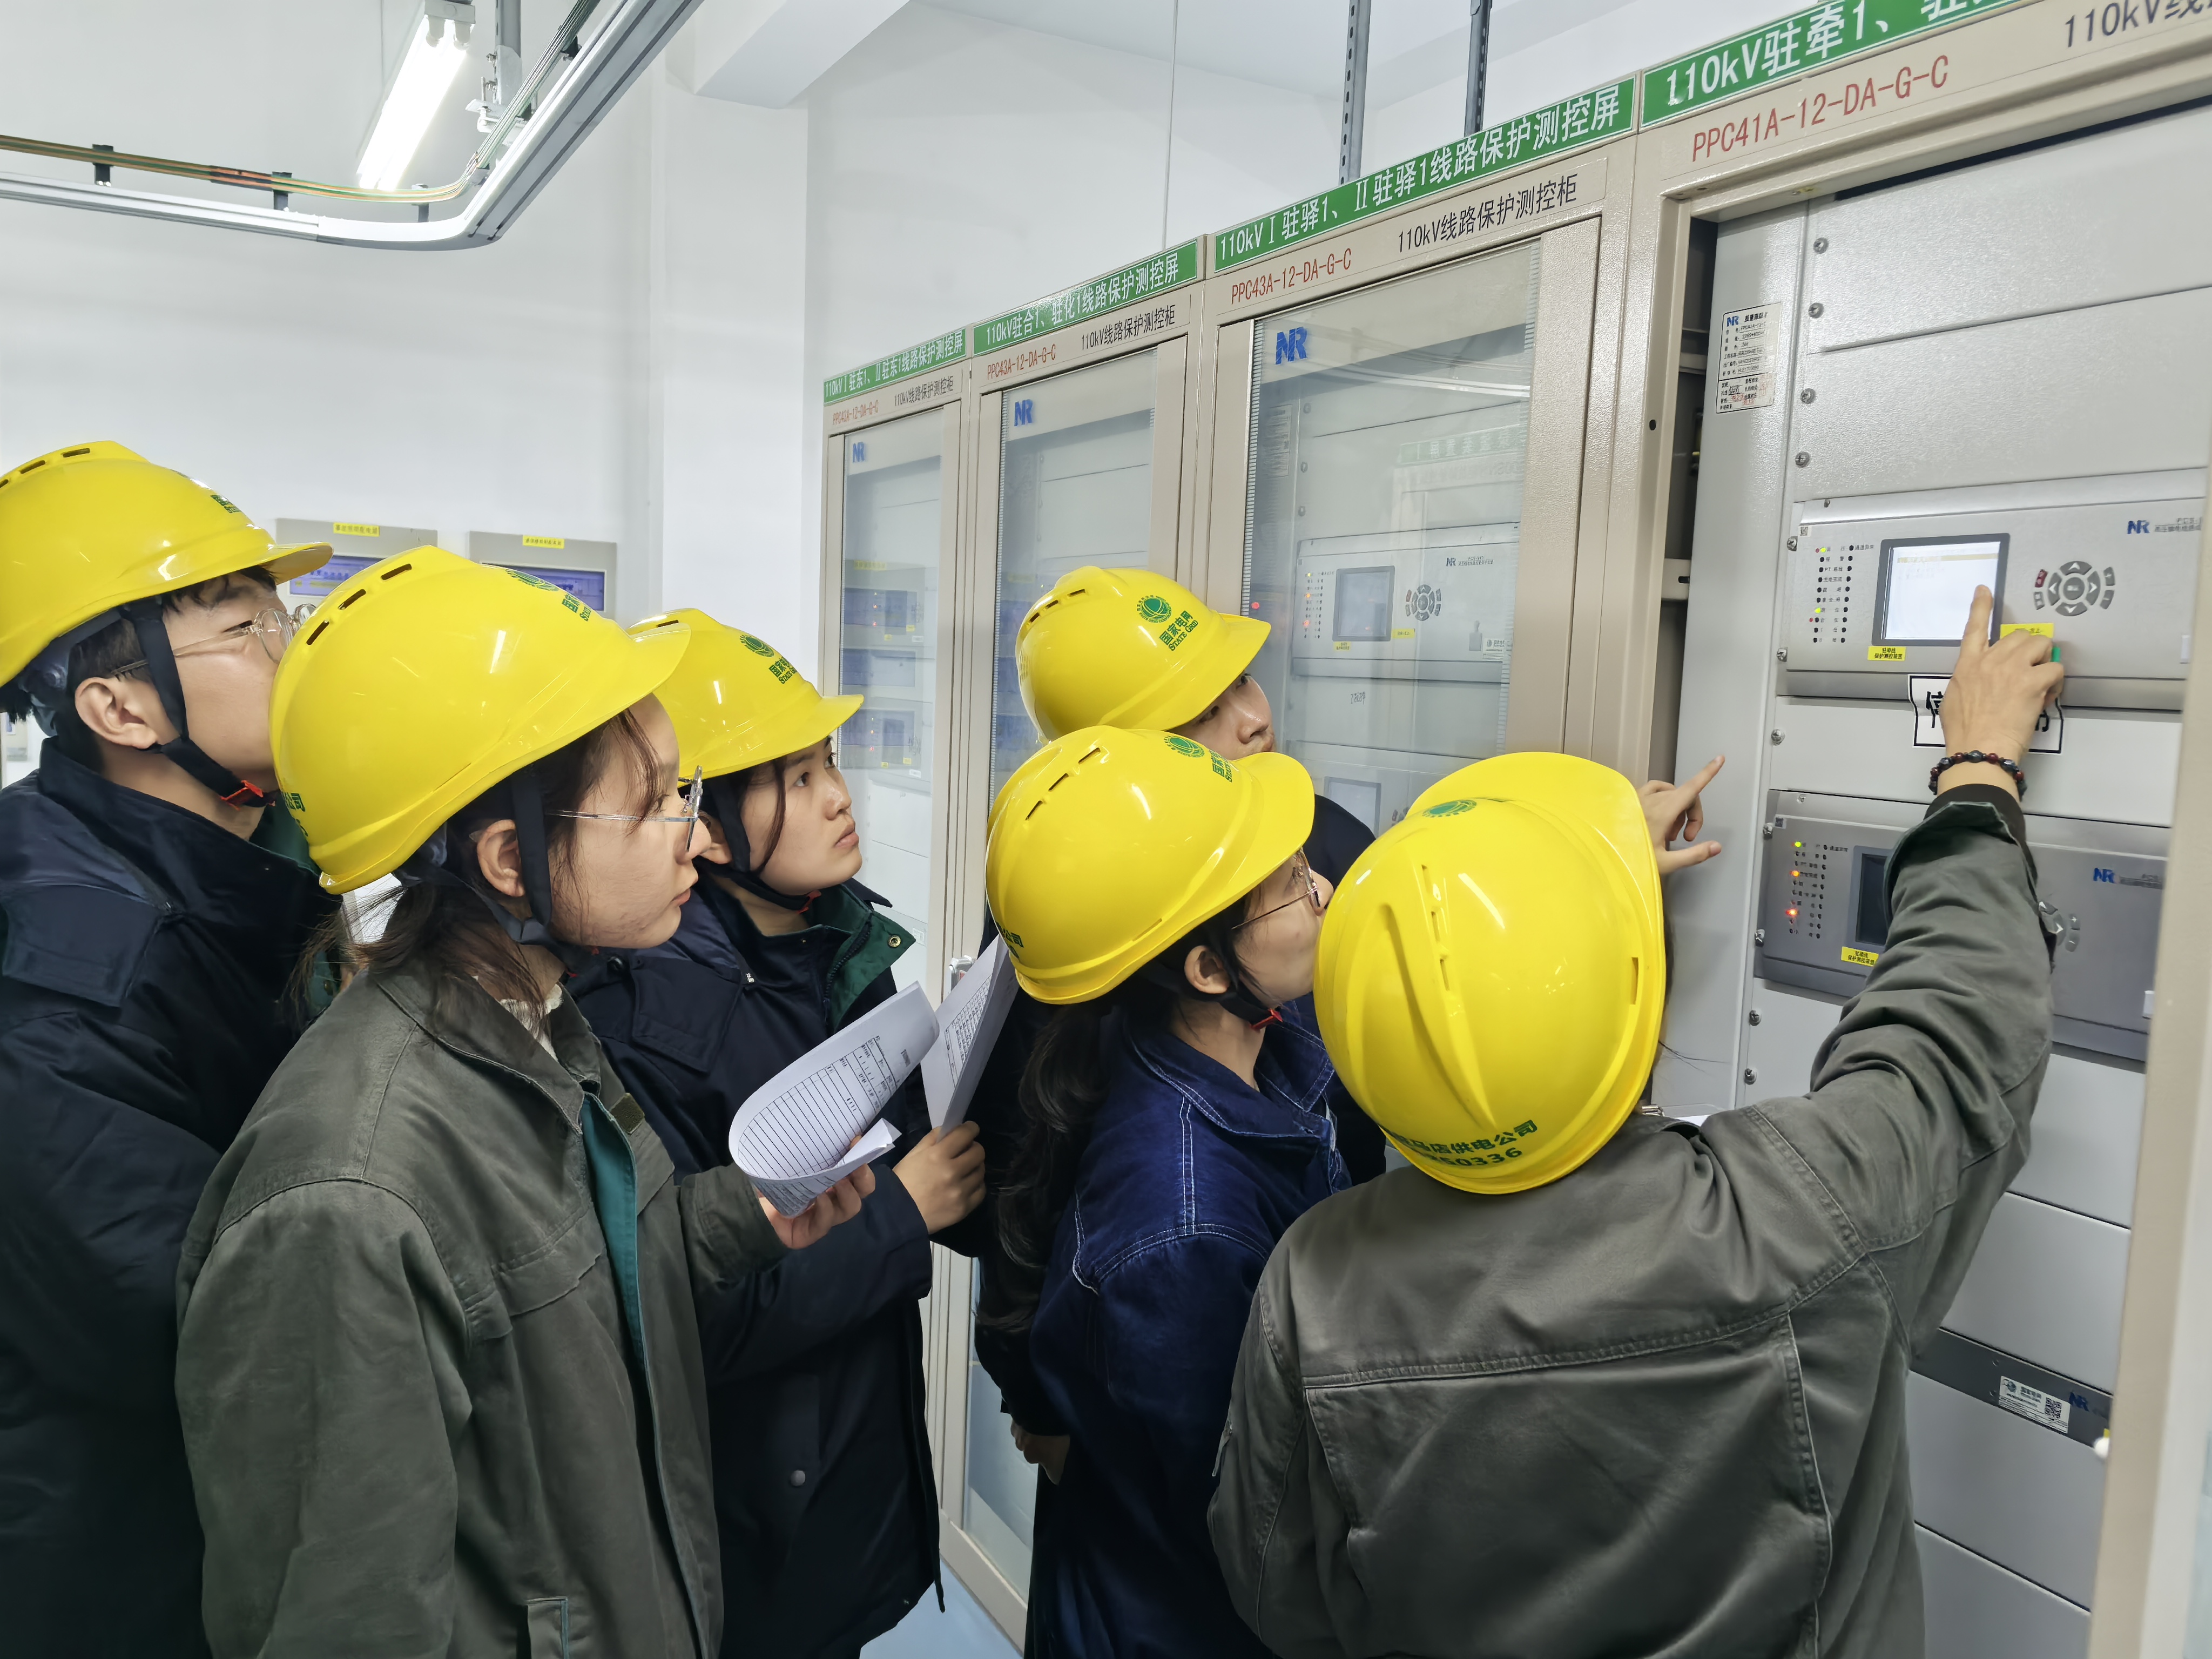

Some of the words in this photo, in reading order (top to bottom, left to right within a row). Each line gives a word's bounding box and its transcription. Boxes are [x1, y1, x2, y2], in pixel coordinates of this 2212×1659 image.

[1692, 55, 1949, 162] PPC41A-12-DA-G-C
[1399, 174, 1578, 253] 110kV线路保护测控柜
[1231, 249, 1352, 305] PPC43A-12-DA-G-C
[1081, 305, 1176, 350] 110kV线路保护测控柜
[1727, 315, 1739, 327] NR
[987, 343, 1056, 380] PPC43A-12-DA-G-C
[1275, 327, 1307, 365] NR
[1014, 399, 1033, 427] NR
[852, 442, 865, 463] NR
[2127, 520, 2150, 534] NR
[1159, 610, 1193, 645] 国家电网
[2093, 867, 2115, 884] NR
[2069, 1391, 2089, 1412] NR
